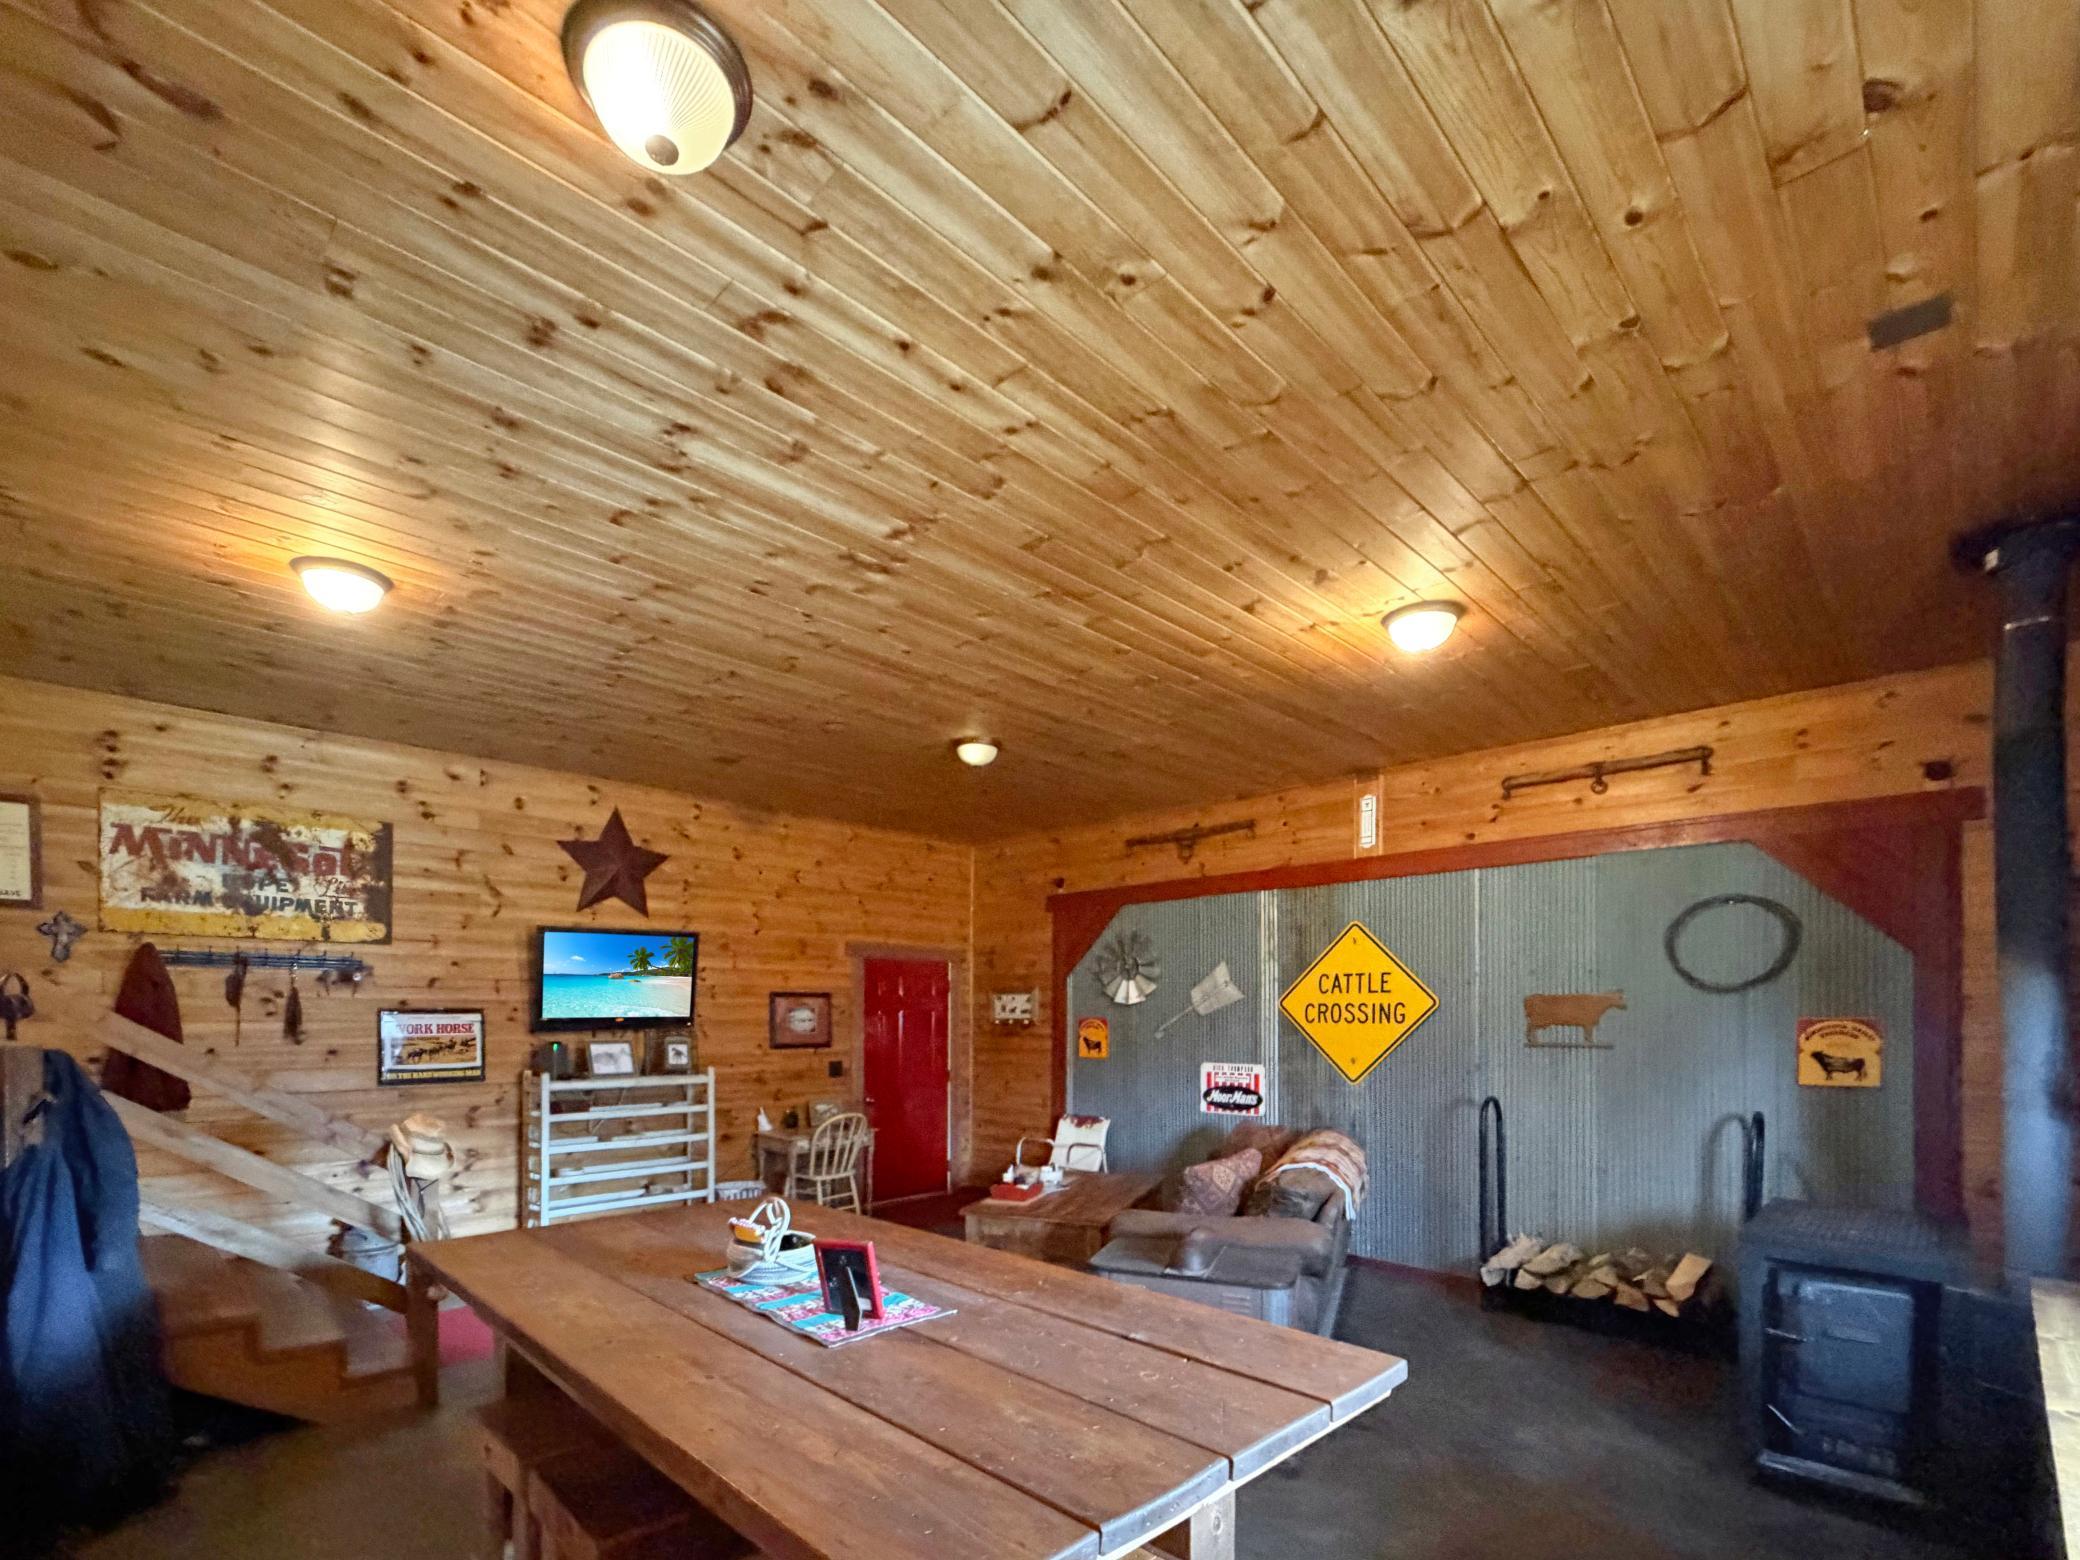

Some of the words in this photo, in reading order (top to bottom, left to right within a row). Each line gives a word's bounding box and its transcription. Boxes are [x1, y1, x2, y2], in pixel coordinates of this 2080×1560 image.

[1318, 972, 1392, 994] CATTLE
[1304, 1002, 1406, 1024] CROSSING
[436, 1023, 475, 1034] HORSE
